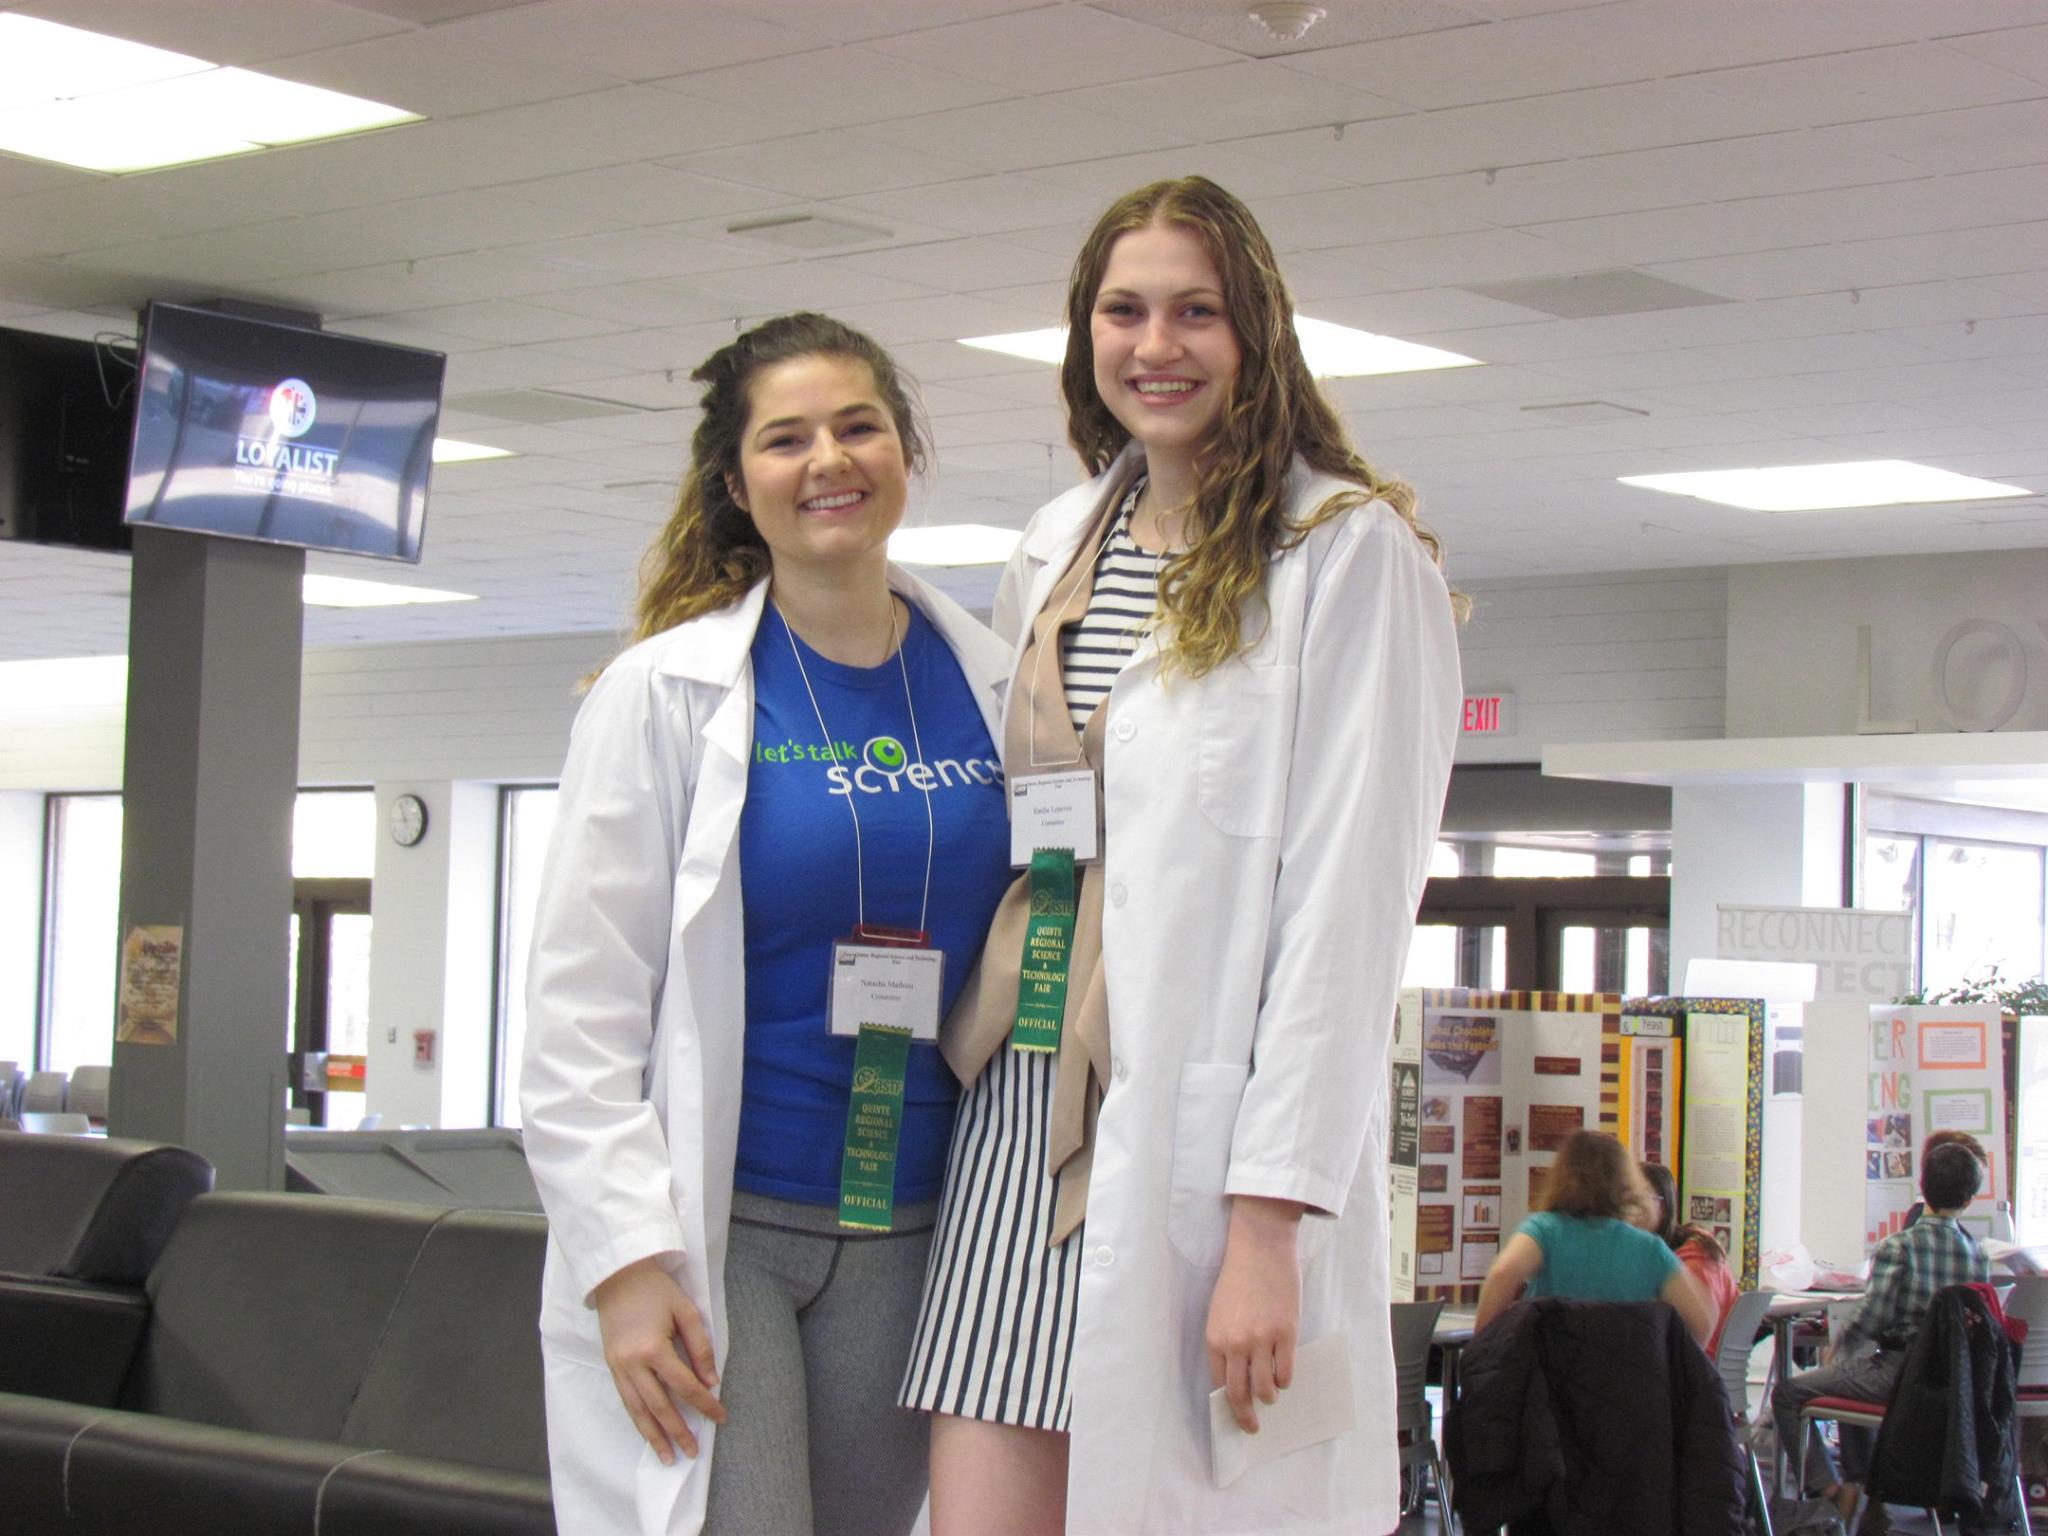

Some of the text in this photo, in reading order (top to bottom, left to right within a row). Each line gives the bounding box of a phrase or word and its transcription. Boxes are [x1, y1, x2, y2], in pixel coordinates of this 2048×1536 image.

[236, 439, 339, 477] LOYALIST
[1856, 618, 2048, 735] LO
[1463, 697, 1501, 731] EXIT
[756, 739, 858, 764] let's talk
[1037, 926, 1062, 937] QUINTE
[1717, 909, 1912, 954] RECONNECT
[1030, 937, 1066, 949] REGIONAL
[1032, 949, 1061, 961] SCIENCE
[1022, 969, 1066, 983] TECHNOLOGY
[1034, 983, 1051, 993] FAIR
[1018, 1016, 1057, 1030] OFFICIAL
[862, 1103, 891, 1115] QUINTE
[855, 1114, 894, 1128] REGIONAL
[857, 1127, 889, 1140] SCIENCE
[847, 1147, 895, 1161] TECHNOLOGY
[860, 1160, 878, 1172] FAIR
[844, 1194, 888, 1210] OFFICIAL
